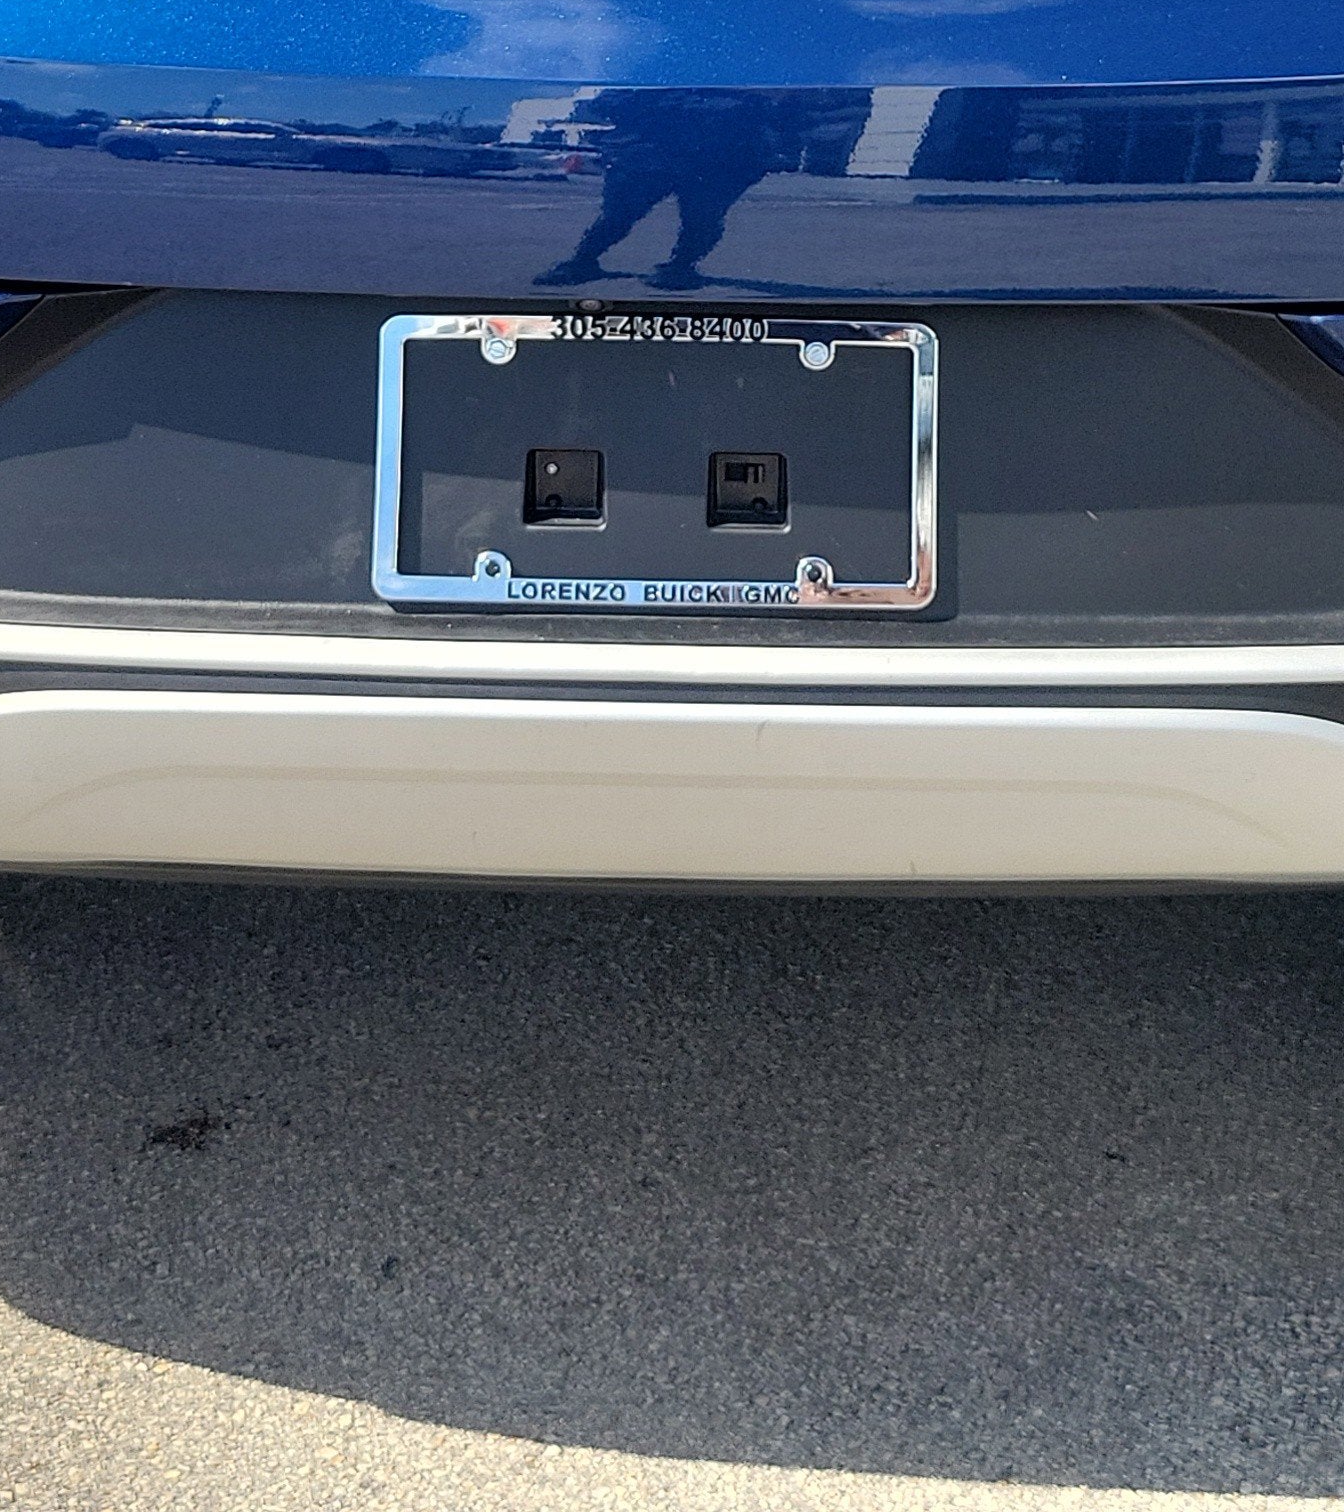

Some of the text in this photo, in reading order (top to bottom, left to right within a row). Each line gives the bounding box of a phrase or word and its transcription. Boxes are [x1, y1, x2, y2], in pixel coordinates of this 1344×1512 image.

[552, 315, 767, 342] 305-436-8400
[506, 581, 802, 605] LORENZO BUICK GMC
